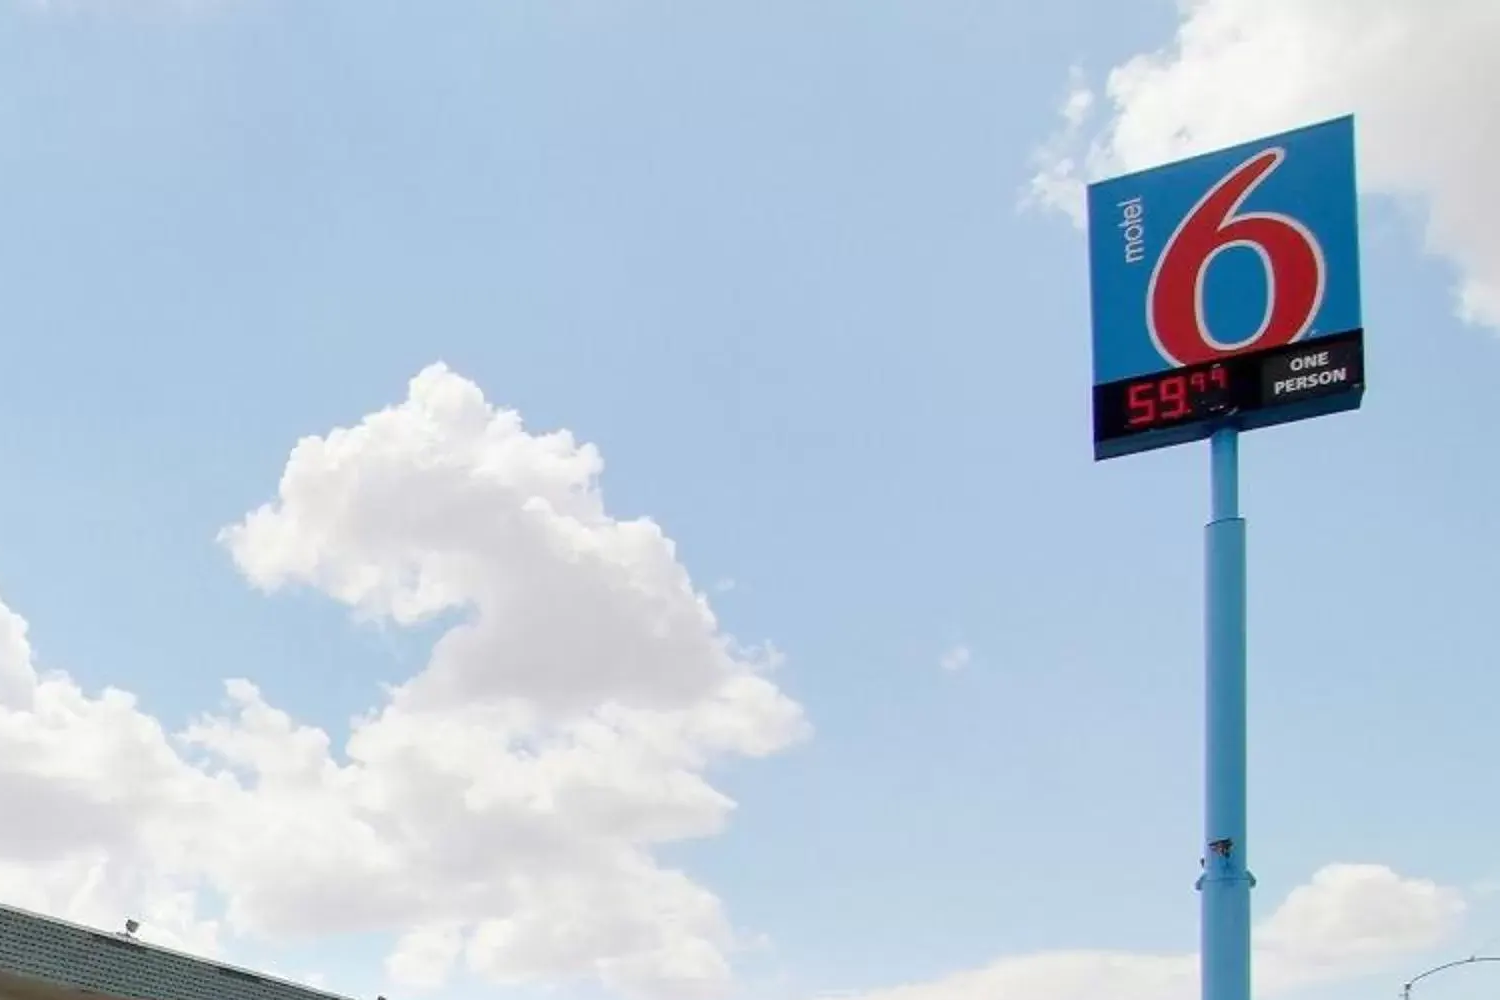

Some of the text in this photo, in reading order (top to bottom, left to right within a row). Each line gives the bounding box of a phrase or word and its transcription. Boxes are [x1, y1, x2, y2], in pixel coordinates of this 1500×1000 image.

[1116, 147, 1326, 367] motel 6
[1289, 351, 1329, 372] ONE
[1273, 367, 1346, 395] PERSON
